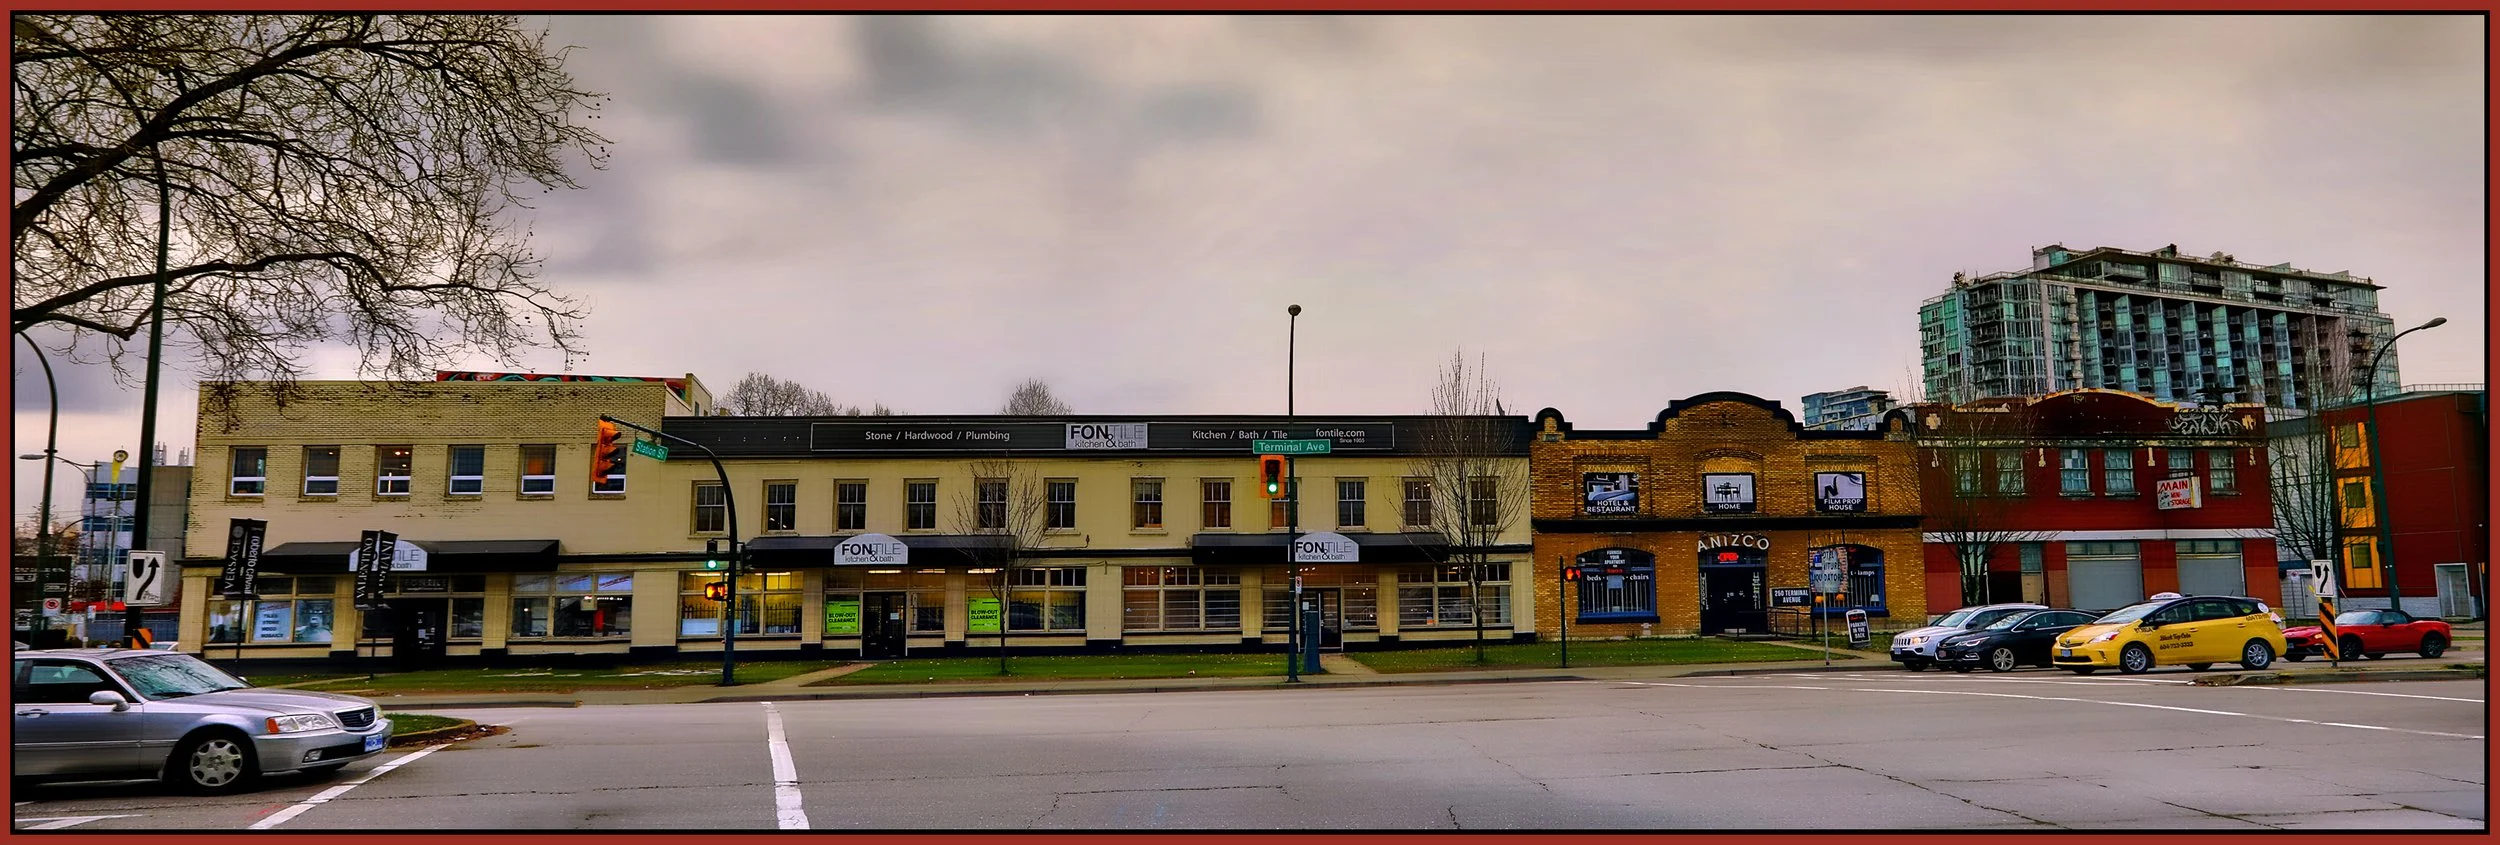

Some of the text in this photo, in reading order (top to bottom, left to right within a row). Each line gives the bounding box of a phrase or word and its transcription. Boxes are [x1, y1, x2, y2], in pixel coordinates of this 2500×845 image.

[865, 430, 892, 440] Stone
[904, 430, 953, 440] Hardwood
[965, 430, 1010, 442] Plumbing
[1070, 424, 1145, 439] FONTILE
[1192, 430, 1226, 439] Kitchen
[1238, 430, 1260, 439] Bath
[1272, 430, 1288, 439] Tile
[1315, 428, 1365, 438] fontile.com
[1074, 433, 1137, 448] kitchen & bath
[1258, 442, 1325, 451] Terminal Ave
[635, 441, 665, 459] Station St
[2159, 480, 2189, 493] MAIN
[1586, 505, 1636, 513] RESTAURANT
[841, 542, 902, 555] FONTILE
[1295, 541, 1352, 554] FONTILE
[1697, 534, 1770, 553] ANIZCO
[247, 535, 261, 568] roberto
[869, 550, 879, 563] &
[1321, 548, 1331, 560] &
[224, 540, 241, 589] VERSACE
[356, 537, 374, 599] VALENTINO
[1629, 573, 1650, 581] chairs
